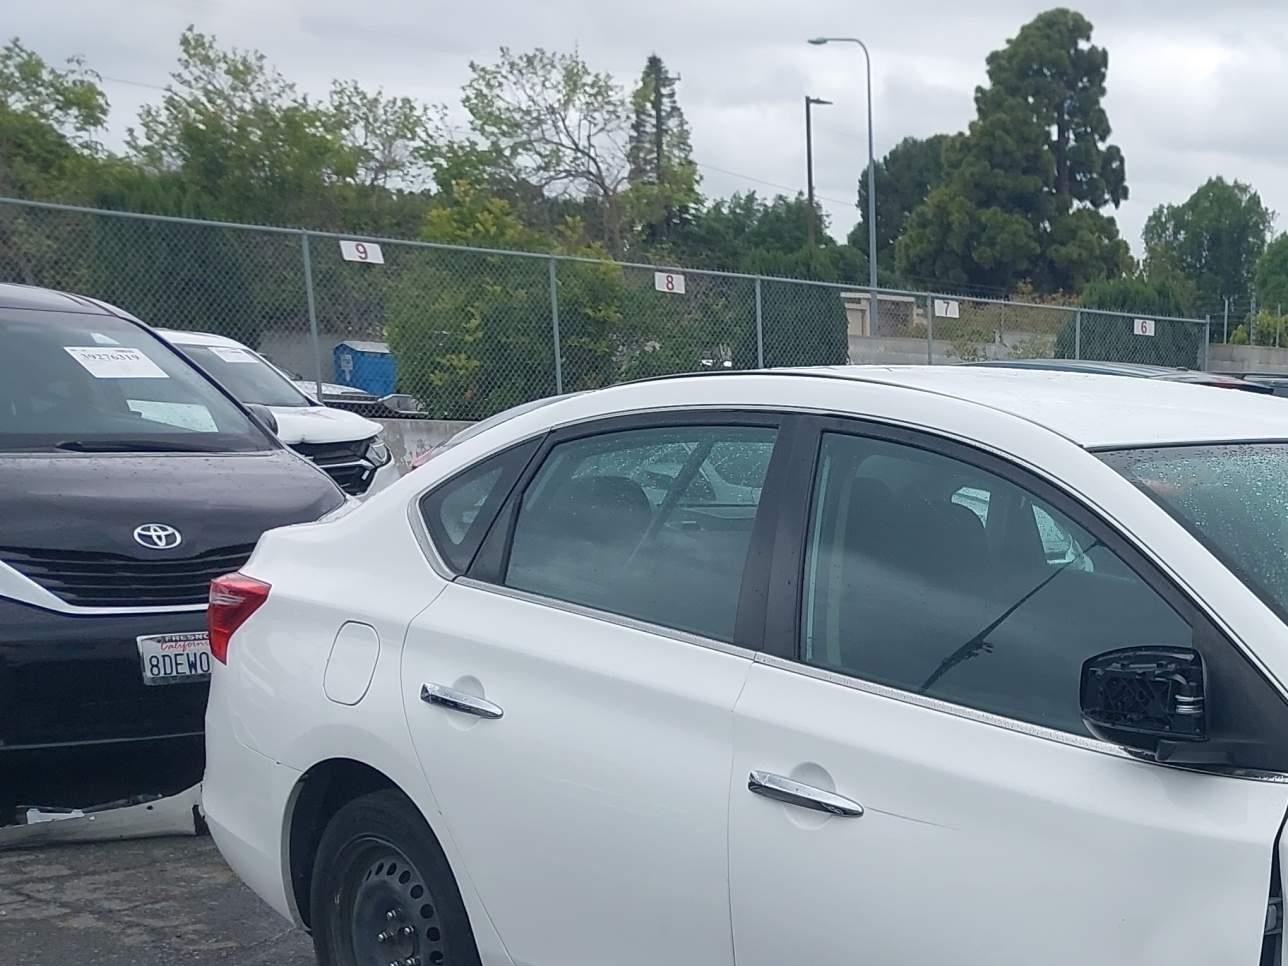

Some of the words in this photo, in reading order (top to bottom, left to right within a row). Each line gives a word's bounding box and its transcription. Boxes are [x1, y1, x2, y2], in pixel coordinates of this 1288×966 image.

[355, 243, 369, 260] 9
[666, 275, 675, 291] 8
[943, 301, 950, 317] 7
[1141, 321, 1148, 334] 6
